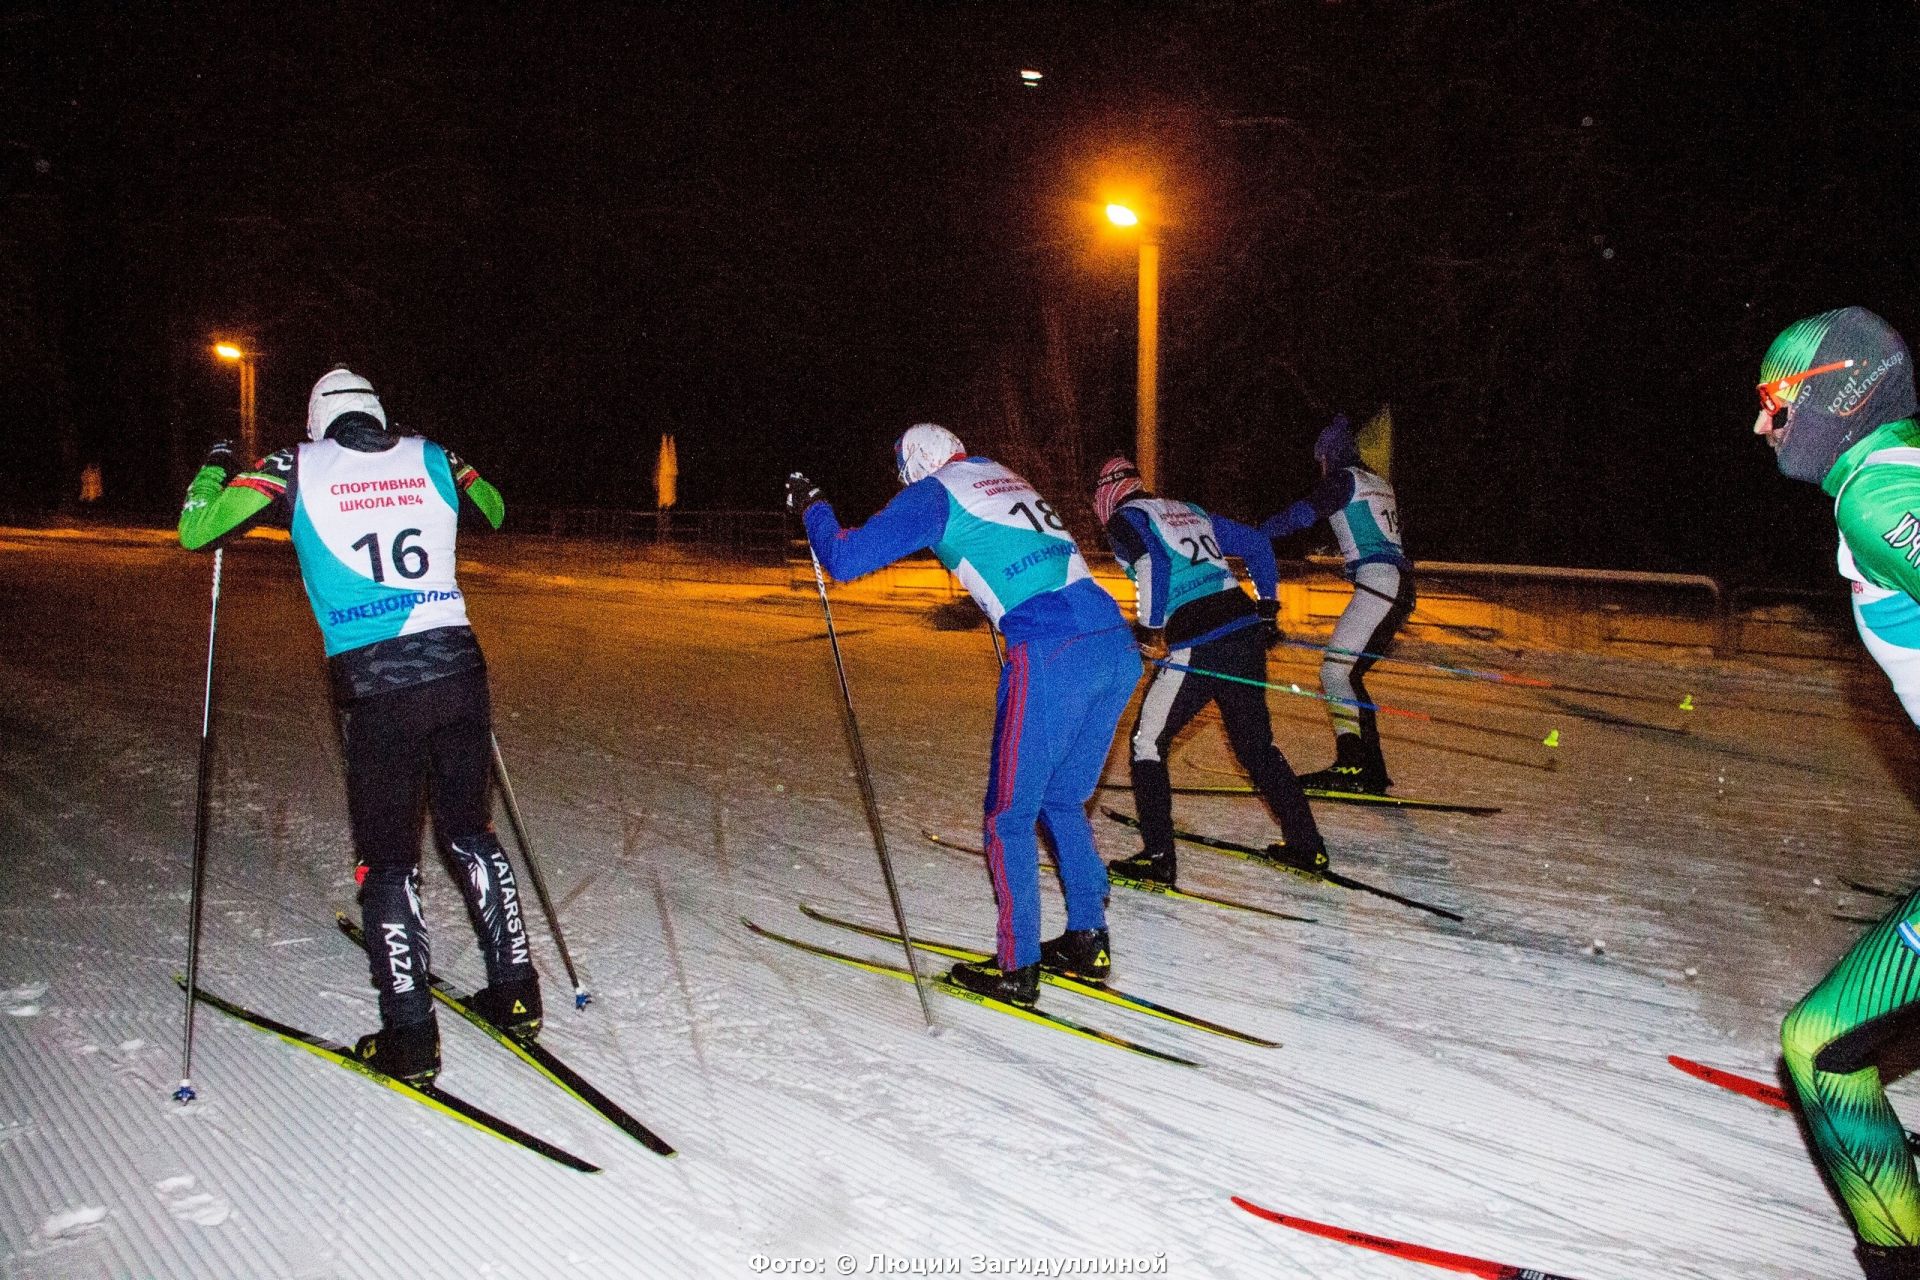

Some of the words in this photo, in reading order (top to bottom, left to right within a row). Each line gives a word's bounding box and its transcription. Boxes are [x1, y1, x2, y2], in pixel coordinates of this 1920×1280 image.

[1828, 376, 1858, 414] total
[1842, 351, 1904, 412] rekneskap
[330, 477, 426, 496] СПОРТИВНАЯ
[339, 497, 395, 512] ШКОЛА
[398, 494, 424, 506] №4
[1008, 499, 1063, 532] 18
[351, 528, 430, 583] 16
[1180, 535, 1222, 566] 20
[491, 852, 529, 964] TATARSTAN
[382, 923, 415, 994] KAZAN
